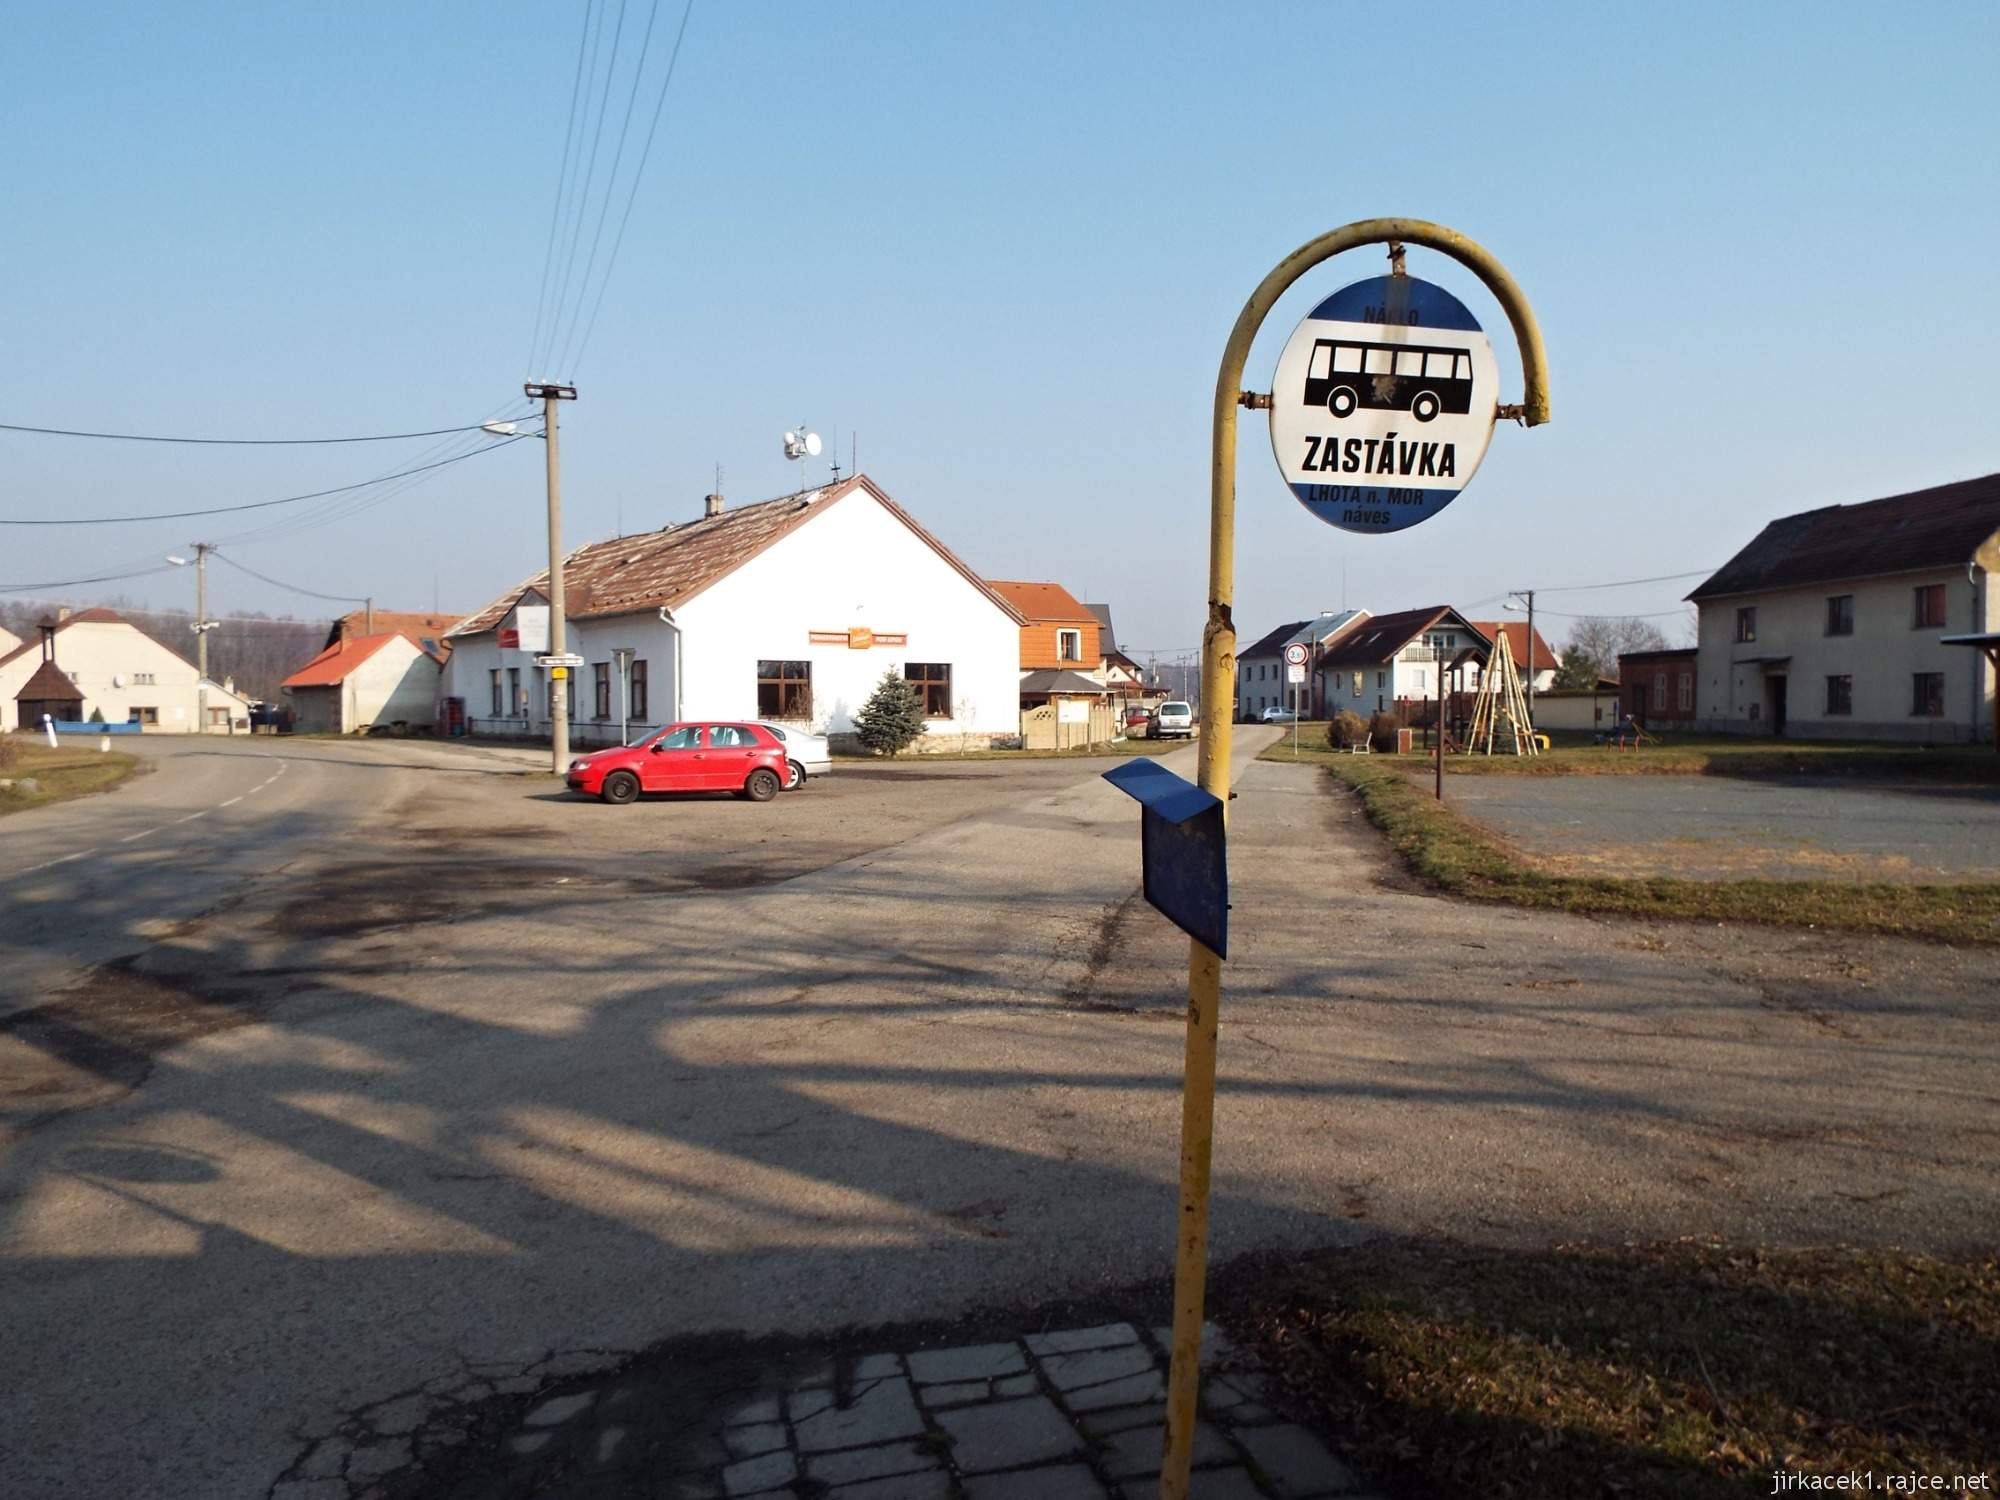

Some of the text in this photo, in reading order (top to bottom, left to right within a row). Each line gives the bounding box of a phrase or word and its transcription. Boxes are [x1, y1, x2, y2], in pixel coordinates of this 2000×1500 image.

[1302, 432, 1456, 477] ZASTÁVKA
[1308, 484, 1425, 505] LHOTA n. MOR
[1343, 505, 1392, 524] náves
